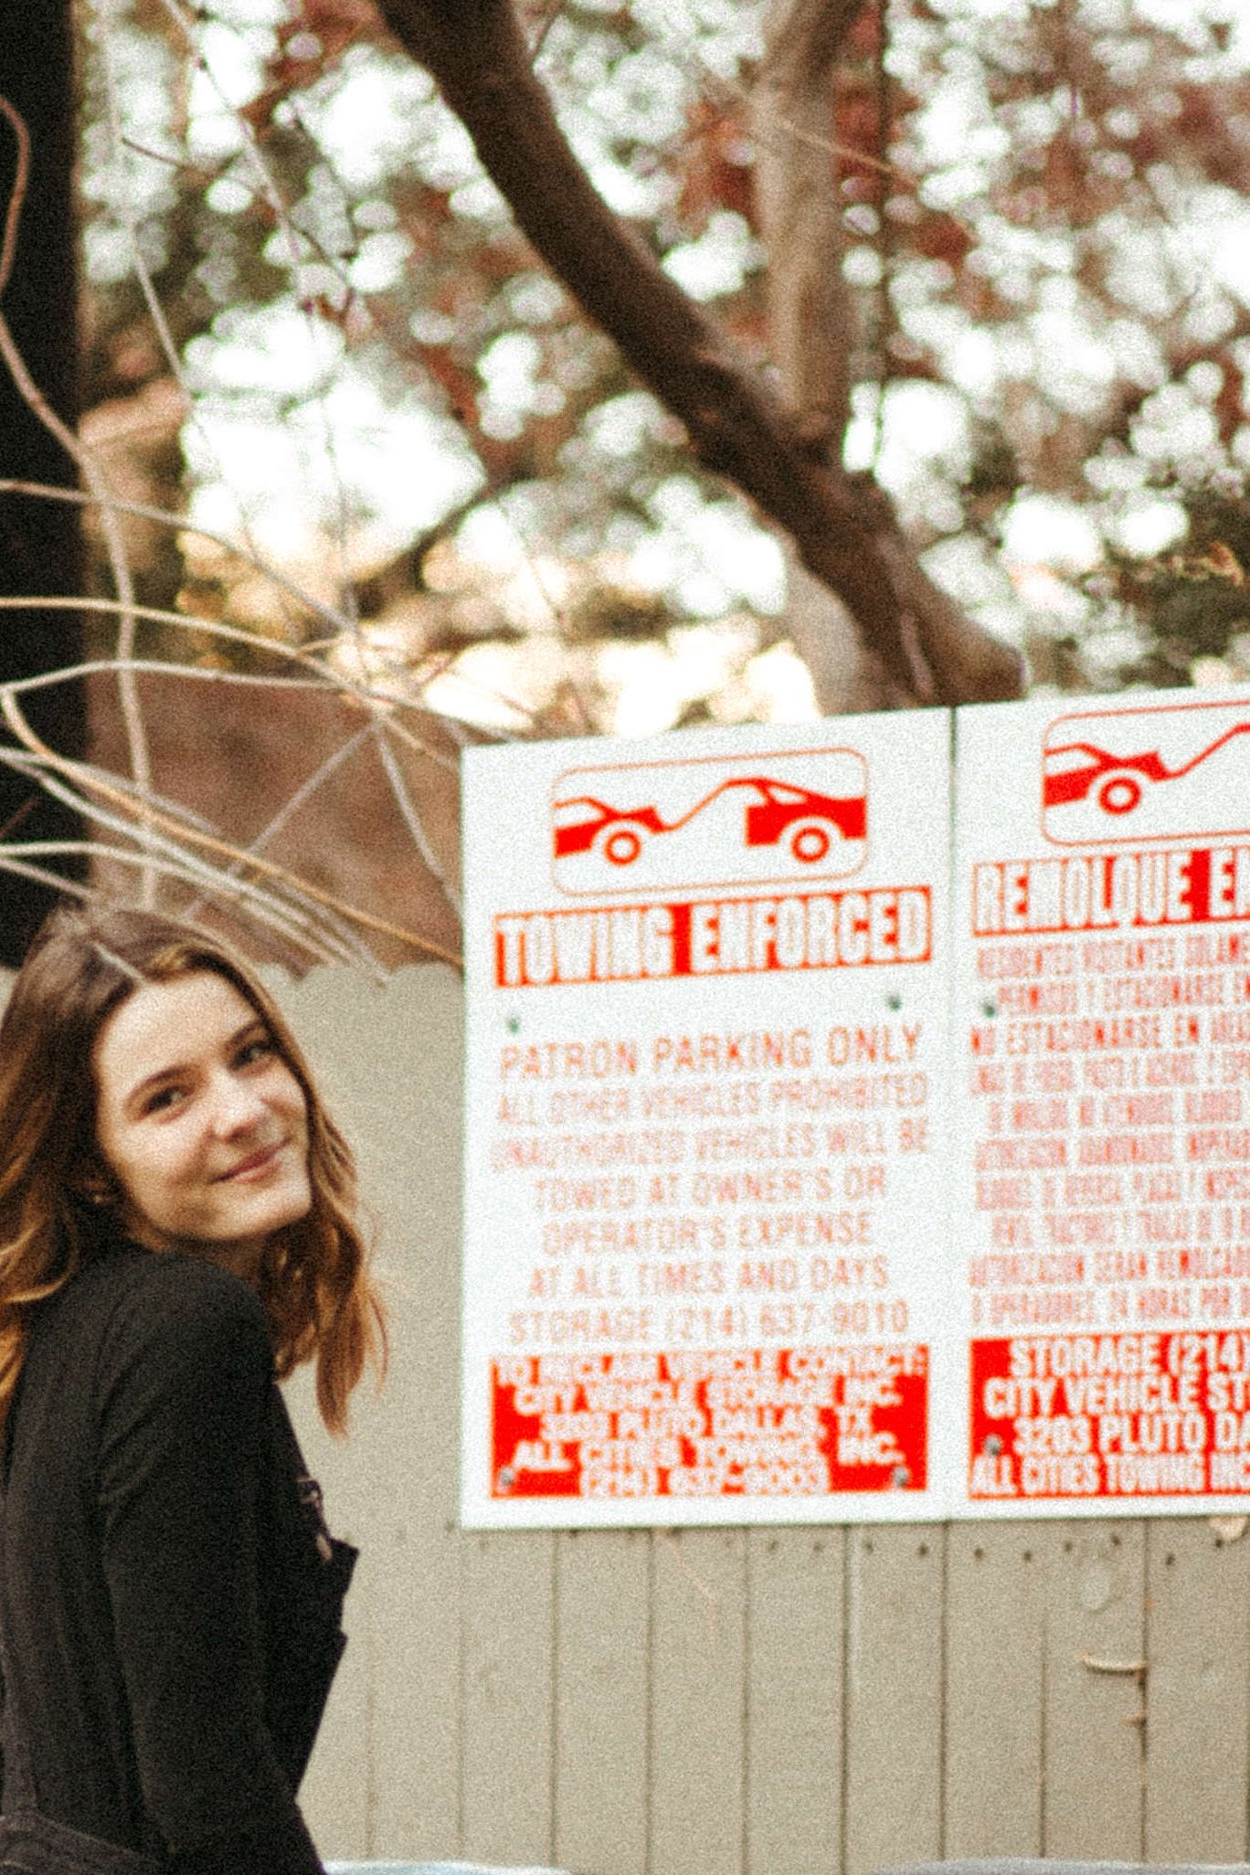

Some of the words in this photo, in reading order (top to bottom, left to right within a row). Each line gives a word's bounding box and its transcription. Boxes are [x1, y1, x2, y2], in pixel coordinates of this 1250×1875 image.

[502, 906, 672, 984] TOWING
[691, 889, 926, 973] ENFORCED
[499, 1039, 638, 1079] PATRON
[652, 1028, 811, 1074] PARKING
[827, 1022, 922, 1067] ONLY
[496, 1093, 537, 1126] ALL
[551, 1087, 630, 1125] OTHER
[642, 1081, 761, 1118] VEHICLES
[769, 1072, 927, 1113] PROHIBITED
[491, 1128, 685, 1173] UNAUTHORIZED
[693, 1122, 814, 1163] VEHICLES
[826, 1119, 888, 1156] WILL
[898, 1115, 930, 1153] BE
[535, 1176, 637, 1213] TOWED
[649, 1173, 679, 1205] AT
[844, 1162, 887, 1199] OR
[738, 1210, 873, 1251] EXPENSE
[528, 1267, 561, 1300] AT
[571, 1264, 621, 1298] ALL
[638, 1259, 724, 1297] TIMES
[737, 1256, 799, 1292] AND
[810, 1253, 890, 1292] DAYS
[509, 1306, 650, 1344] STORAGE
[664, 1303, 747, 1340] (214)
[1009, 1335, 1161, 1378] STORAGE
[983, 1376, 1058, 1420] CITY
[1064, 1373, 1201, 1416] VEHICLE
[513, 1441, 572, 1471] ALL
[1012, 1416, 1092, 1457] 3203
[1098, 1410, 1207, 1454] PLUTO
[971, 1456, 1018, 1495] ALL
[1020, 1454, 1100, 1494] CITIES
[1105, 1451, 1206, 1493] TOWING
